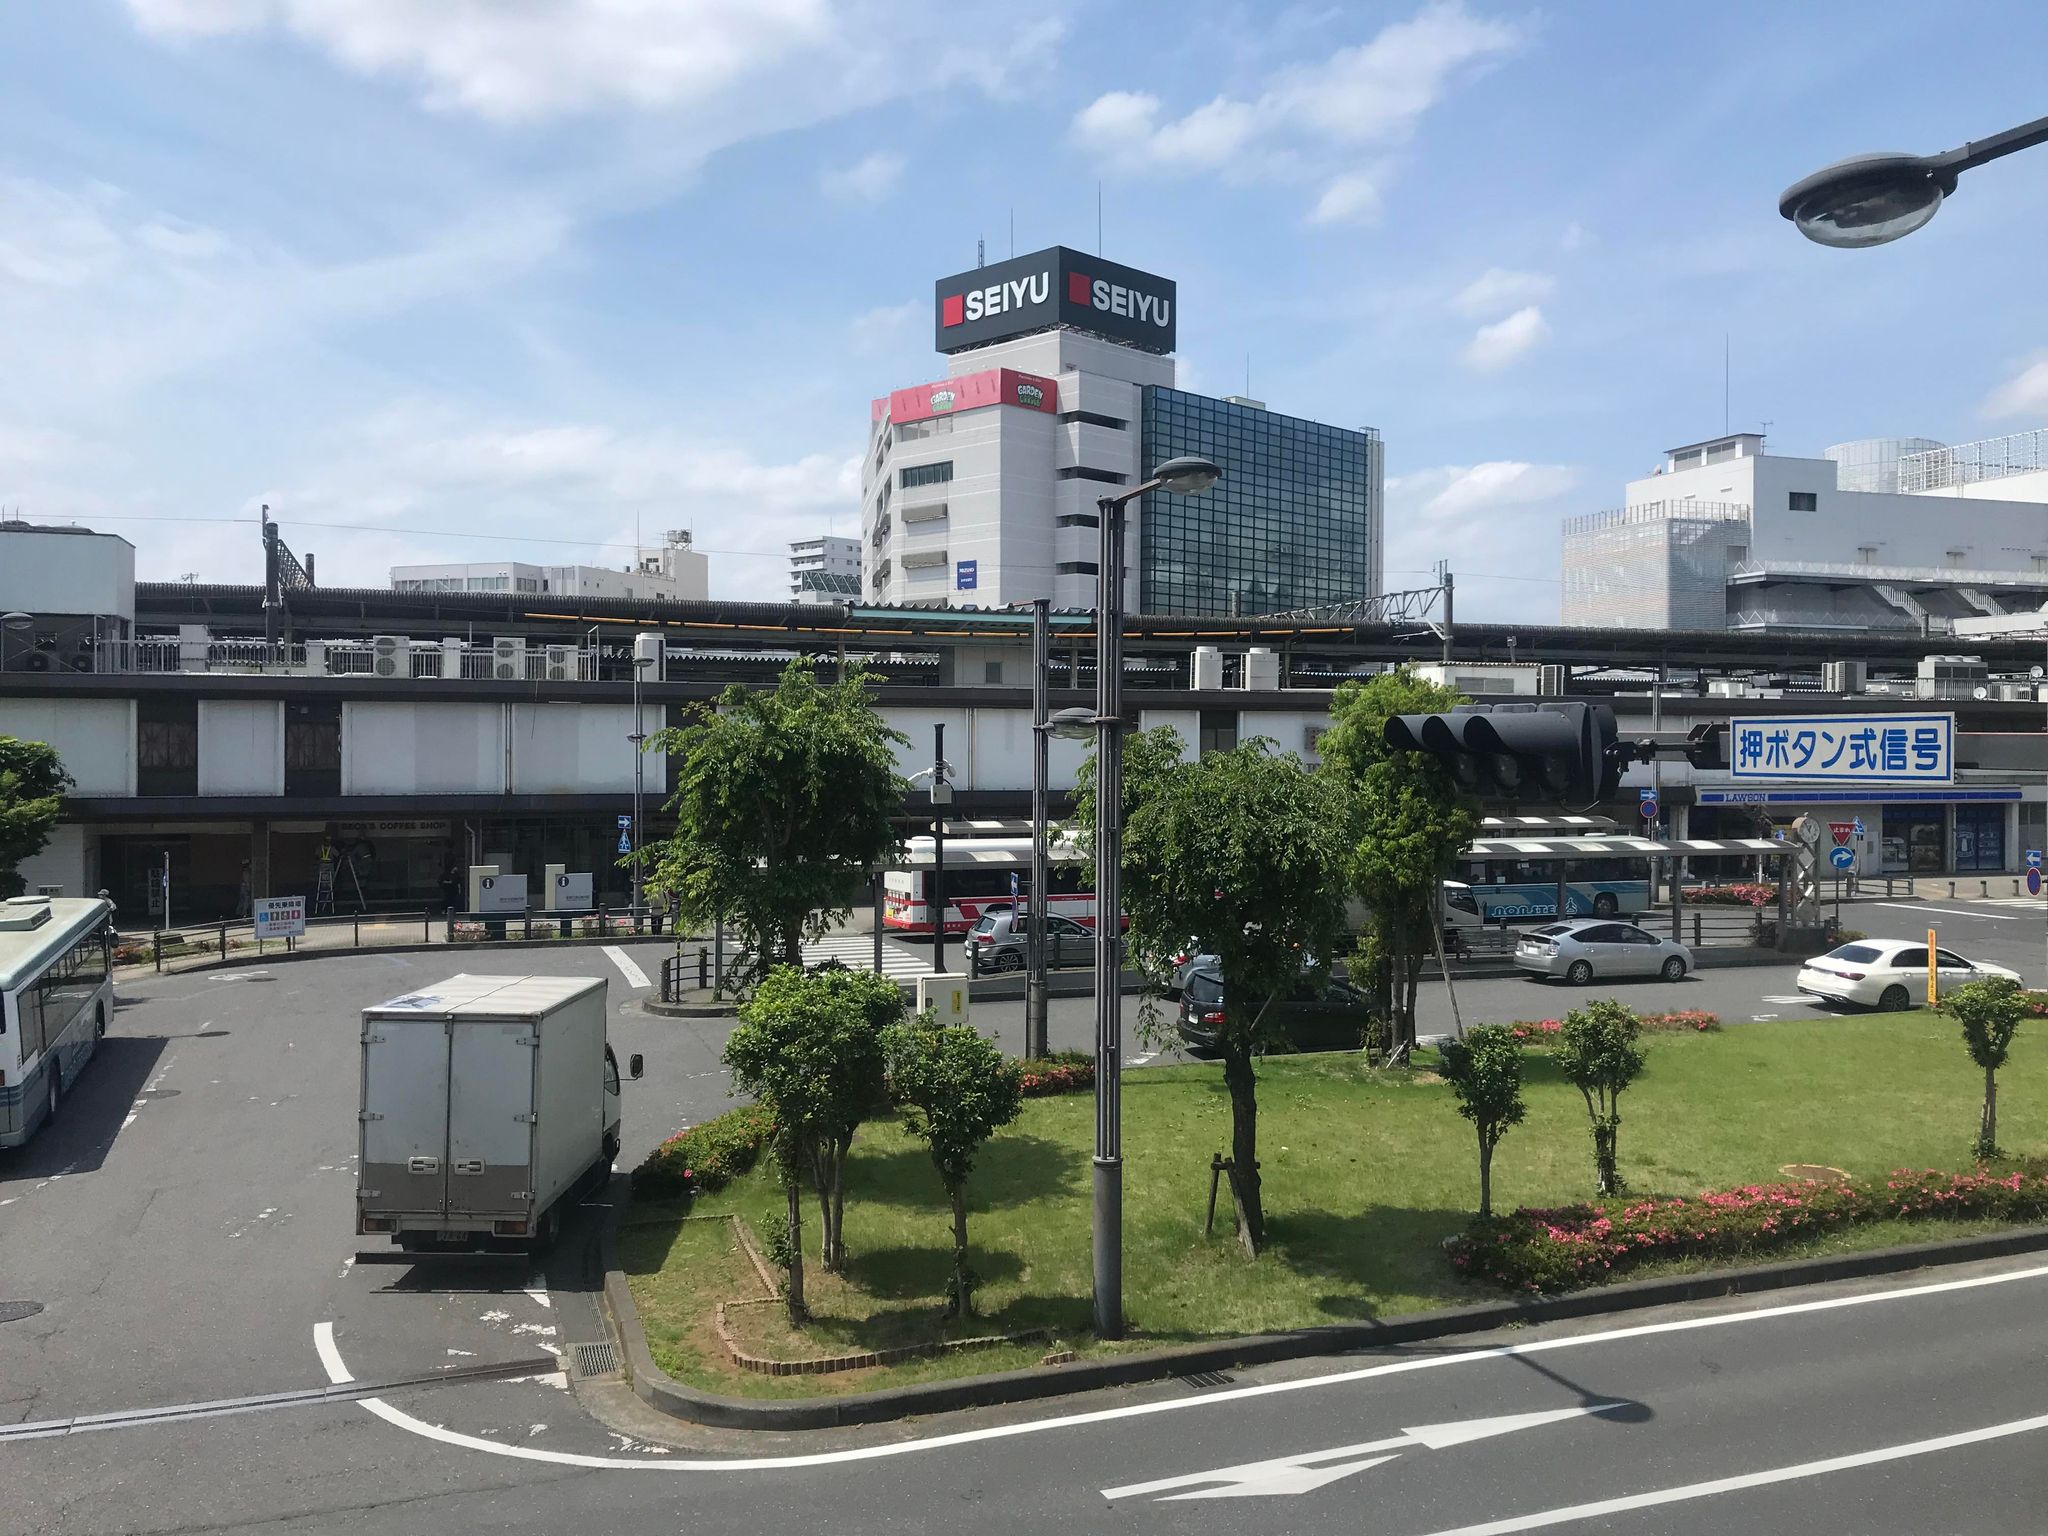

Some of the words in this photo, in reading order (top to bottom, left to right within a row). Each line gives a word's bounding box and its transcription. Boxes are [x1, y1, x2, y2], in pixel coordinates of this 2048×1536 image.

[965, 271, 1049, 321] SEIYU
[1092, 279, 1170, 328] SEIYU
[1017, 384, 1044, 400] GARDEN
[1739, 727, 1942, 772] 押ボタン式信号
[1725, 793, 1766, 802] LAWSON
[379, 822, 416, 830] COFFEE
[420, 821, 446, 830] SHOP
